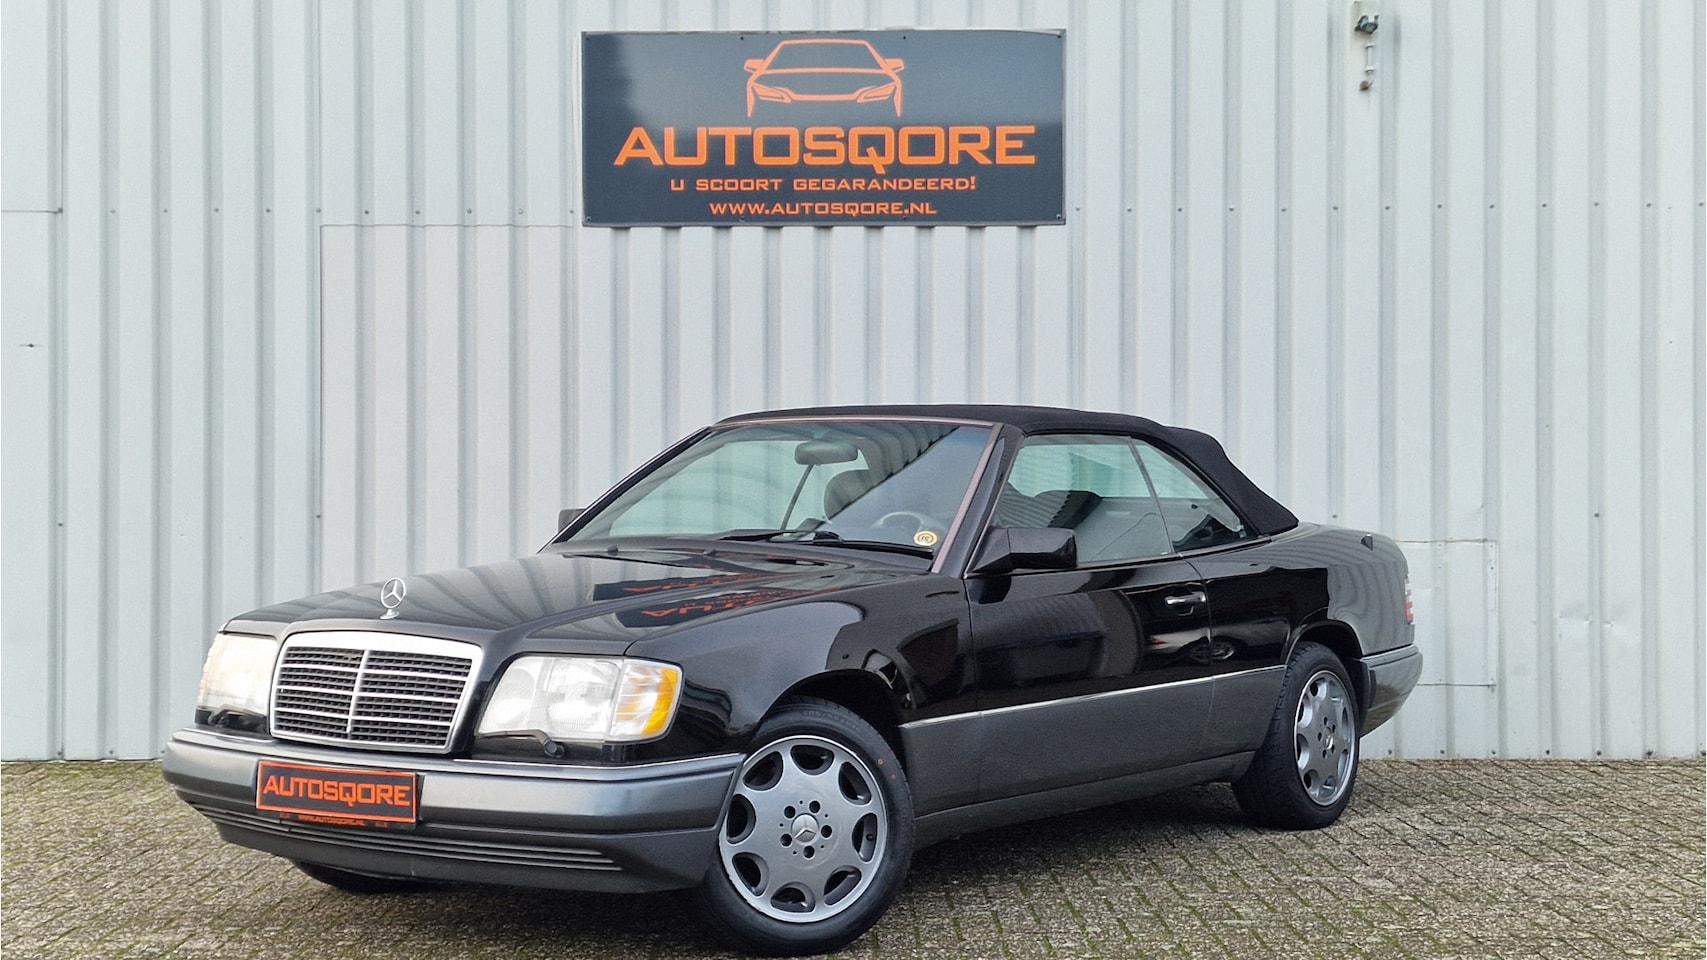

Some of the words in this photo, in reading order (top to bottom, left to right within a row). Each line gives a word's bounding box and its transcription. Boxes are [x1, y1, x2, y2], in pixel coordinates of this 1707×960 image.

[613, 125, 1037, 174] AUTOSQORE
[670, 179, 686, 192] U
[695, 179, 783, 192] SCOORT
[792, 175, 977, 192] GEGARANDEERD!
[709, 202, 937, 218] WWW.AUTOSQORE.NL
[263, 775, 411, 807] AUTOSQORE
